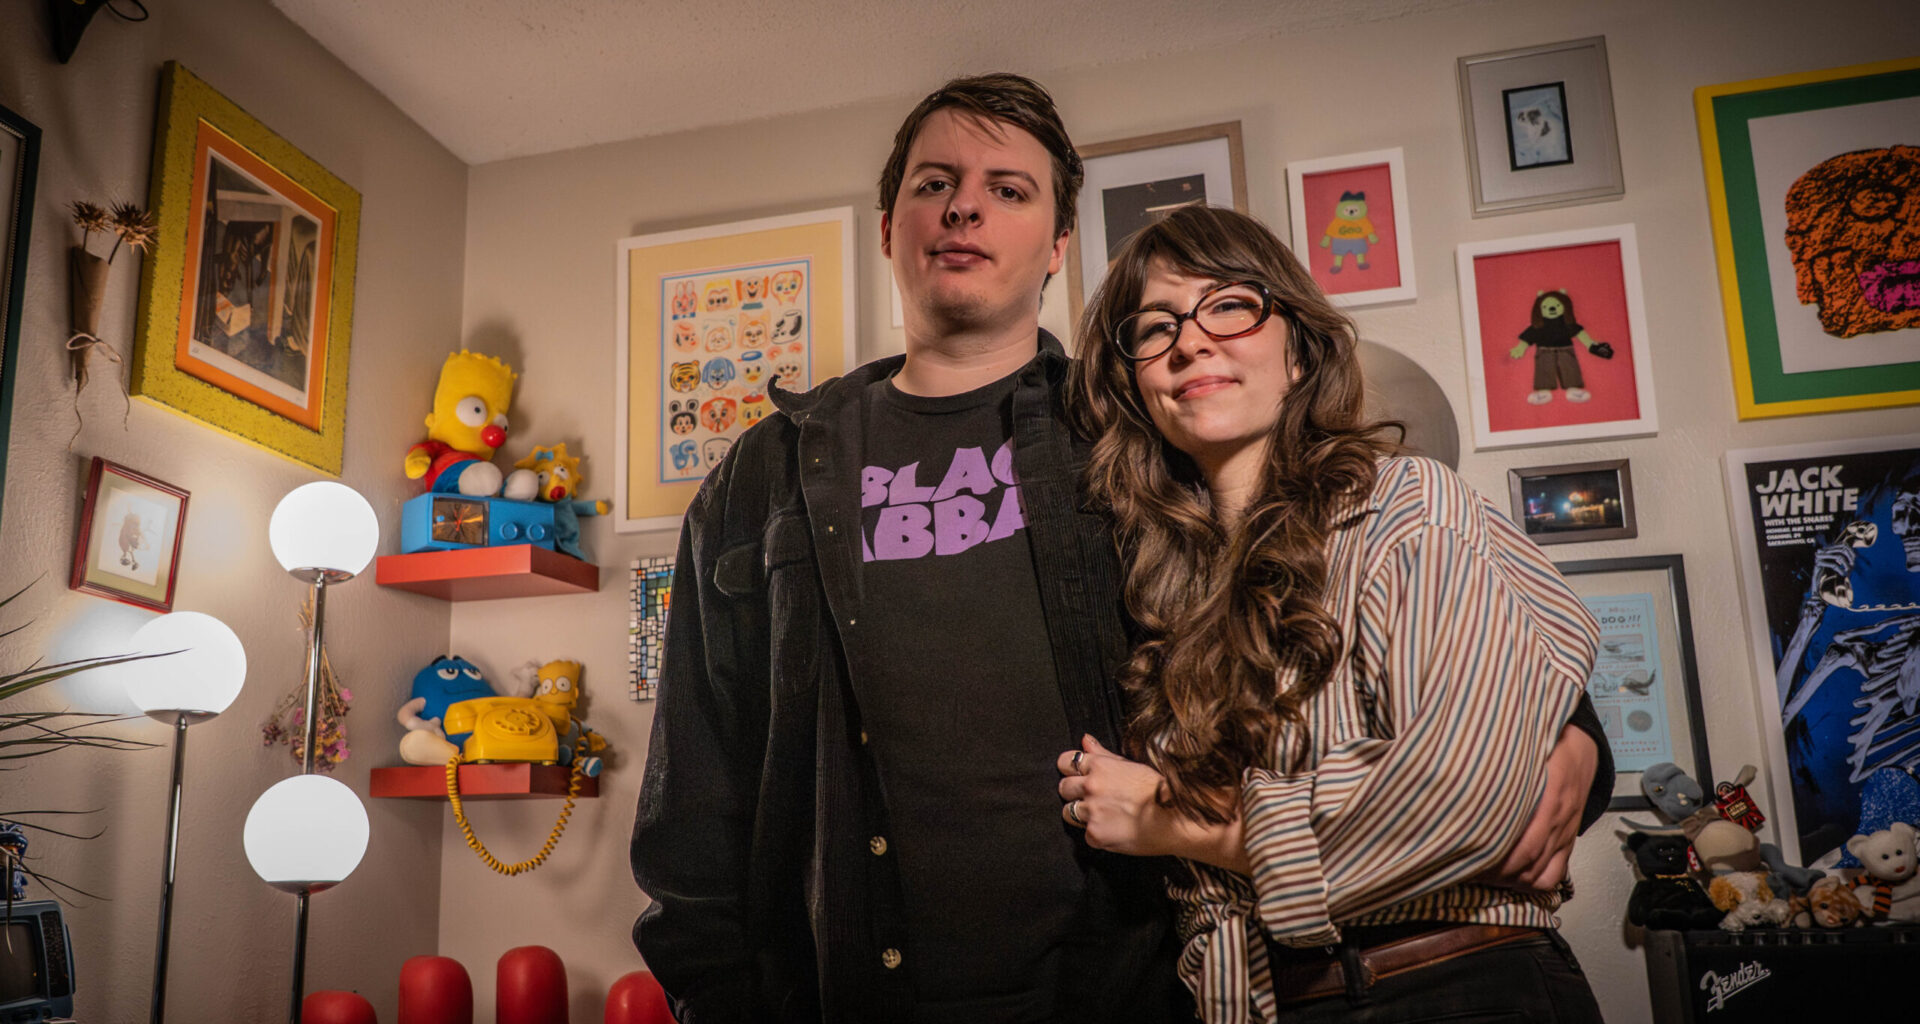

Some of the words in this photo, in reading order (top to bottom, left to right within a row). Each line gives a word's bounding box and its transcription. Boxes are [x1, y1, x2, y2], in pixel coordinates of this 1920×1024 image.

[1755, 465, 1844, 494] JACK
[1760, 488, 1859, 517] WHITE
[1764, 518, 1785, 527] WITH
[1786, 517, 1801, 525] THE
